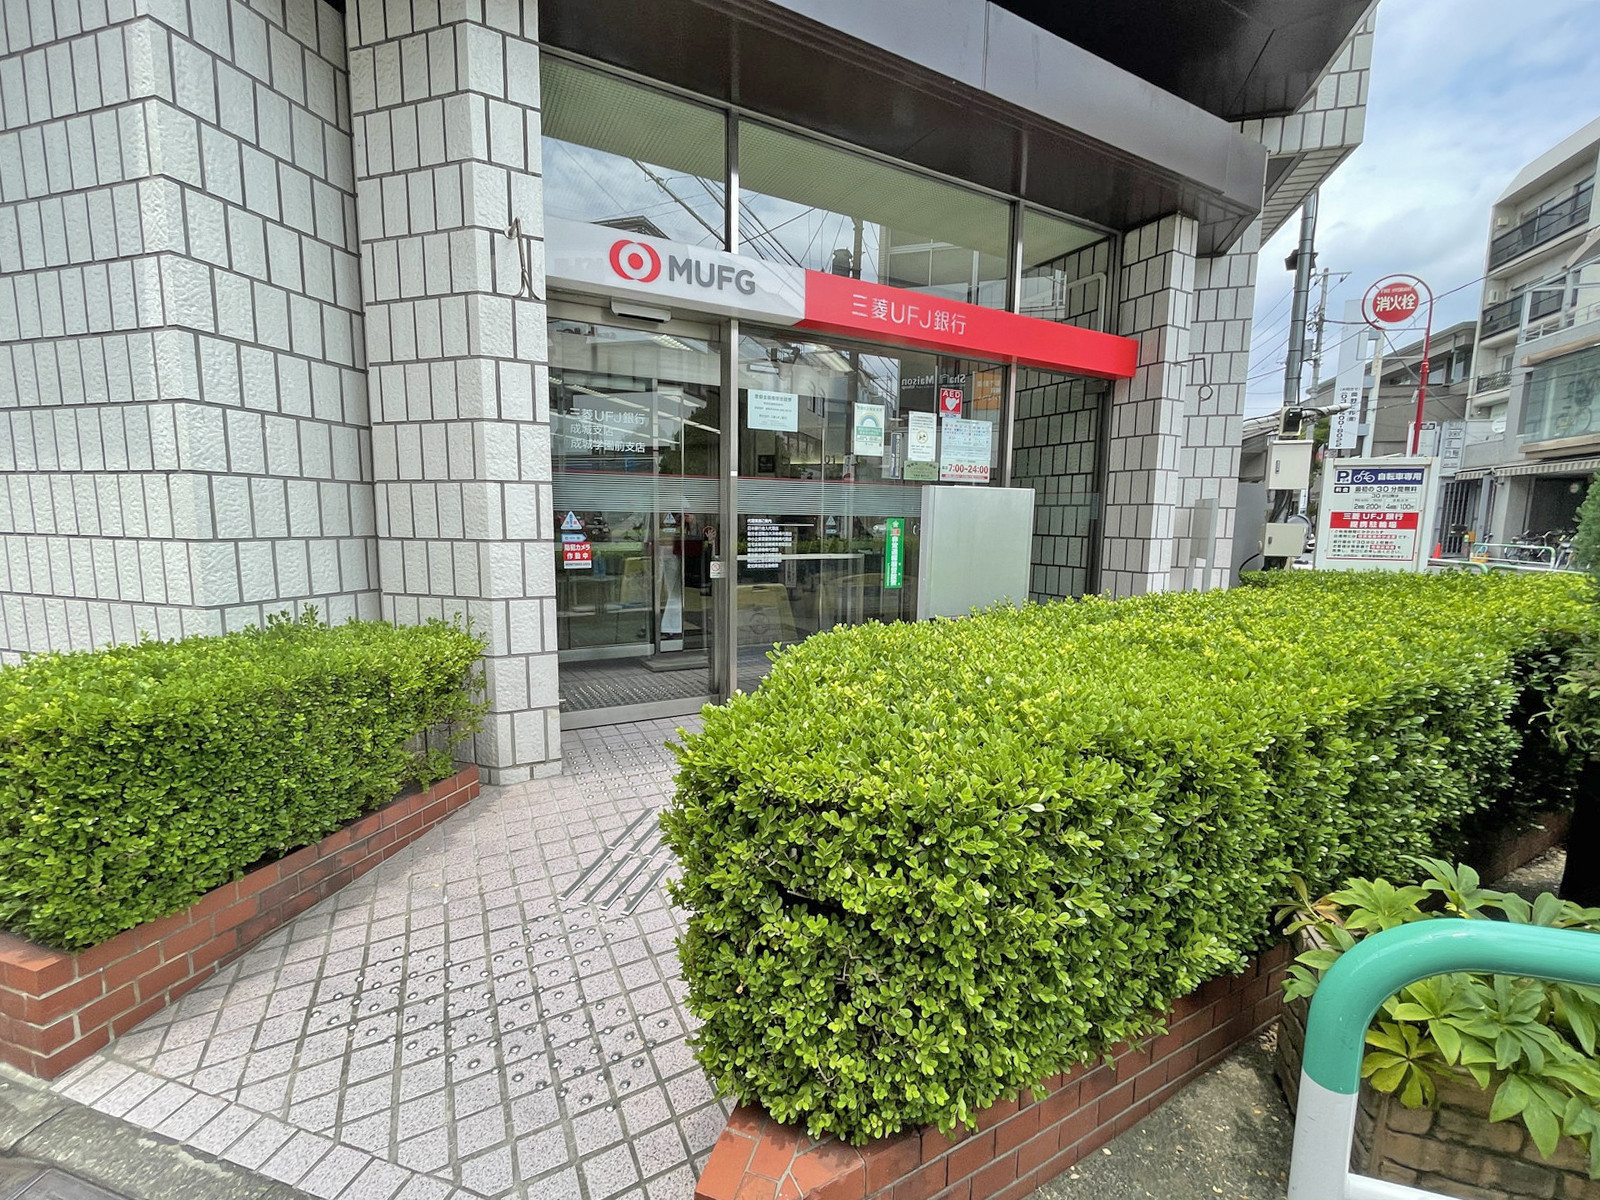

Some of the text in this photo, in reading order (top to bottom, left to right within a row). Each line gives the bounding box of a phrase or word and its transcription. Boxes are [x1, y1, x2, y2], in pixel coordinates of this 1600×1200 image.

[668, 254, 756, 295] MUFG
[1376, 293, 1416, 312] 消火栓
[851, 293, 967, 335] 三菱UFJ銀行
[942, 390, 961, 398] AED
[569, 407, 645, 425] 三菱UFJ銀行
[570, 423, 613, 436] 成城支店
[570, 439, 645, 453] 成城学園前支店
[1378, 472, 1422, 481] 自転車専用
[564, 543, 590, 551] 防犯カメラ
[566, 552, 589, 560] 作動中
